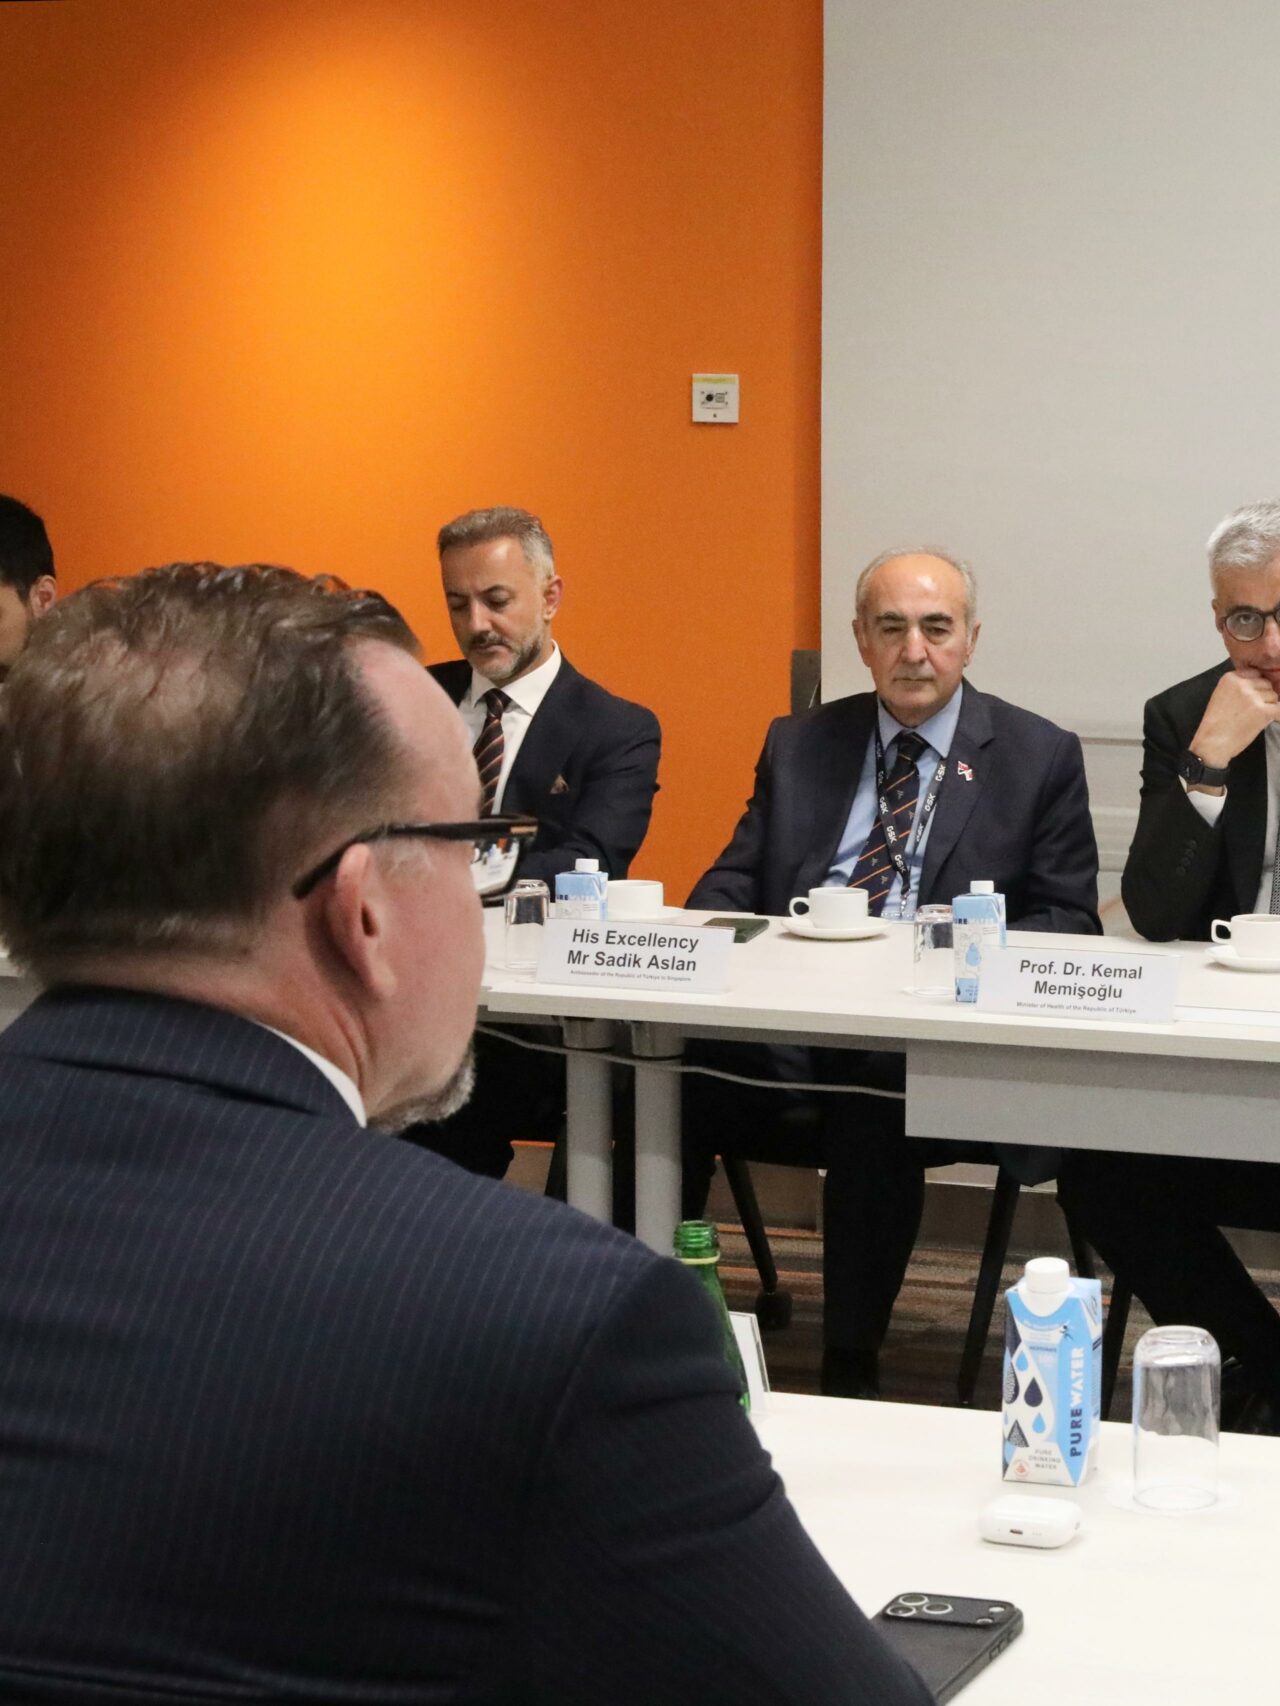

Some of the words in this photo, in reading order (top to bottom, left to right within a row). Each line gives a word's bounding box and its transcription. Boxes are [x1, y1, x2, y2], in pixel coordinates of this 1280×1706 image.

[935, 764, 946, 782] GSK
[880, 796, 889, 815] GSK
[924, 792, 936, 812] GSK
[886, 825, 898, 844] GSK
[894, 854, 906, 873] GSK
[572, 928, 600, 944] His
[605, 930, 699, 953] Excellency
[567, 950, 589, 965] Mr
[594, 952, 642, 968] Sadik
[647, 954, 696, 972] Aslan
[1020, 960, 1057, 974] Prof.
[1063, 962, 1085, 976] Dr.
[1092, 964, 1142, 980] Kemal
[1034, 980, 1122, 1001] Memişoğlu
[1070, 1346, 1085, 1408] WATER
[1070, 1408, 1082, 1458] PURE
[1028, 1455, 1061, 1463] DRINKING
